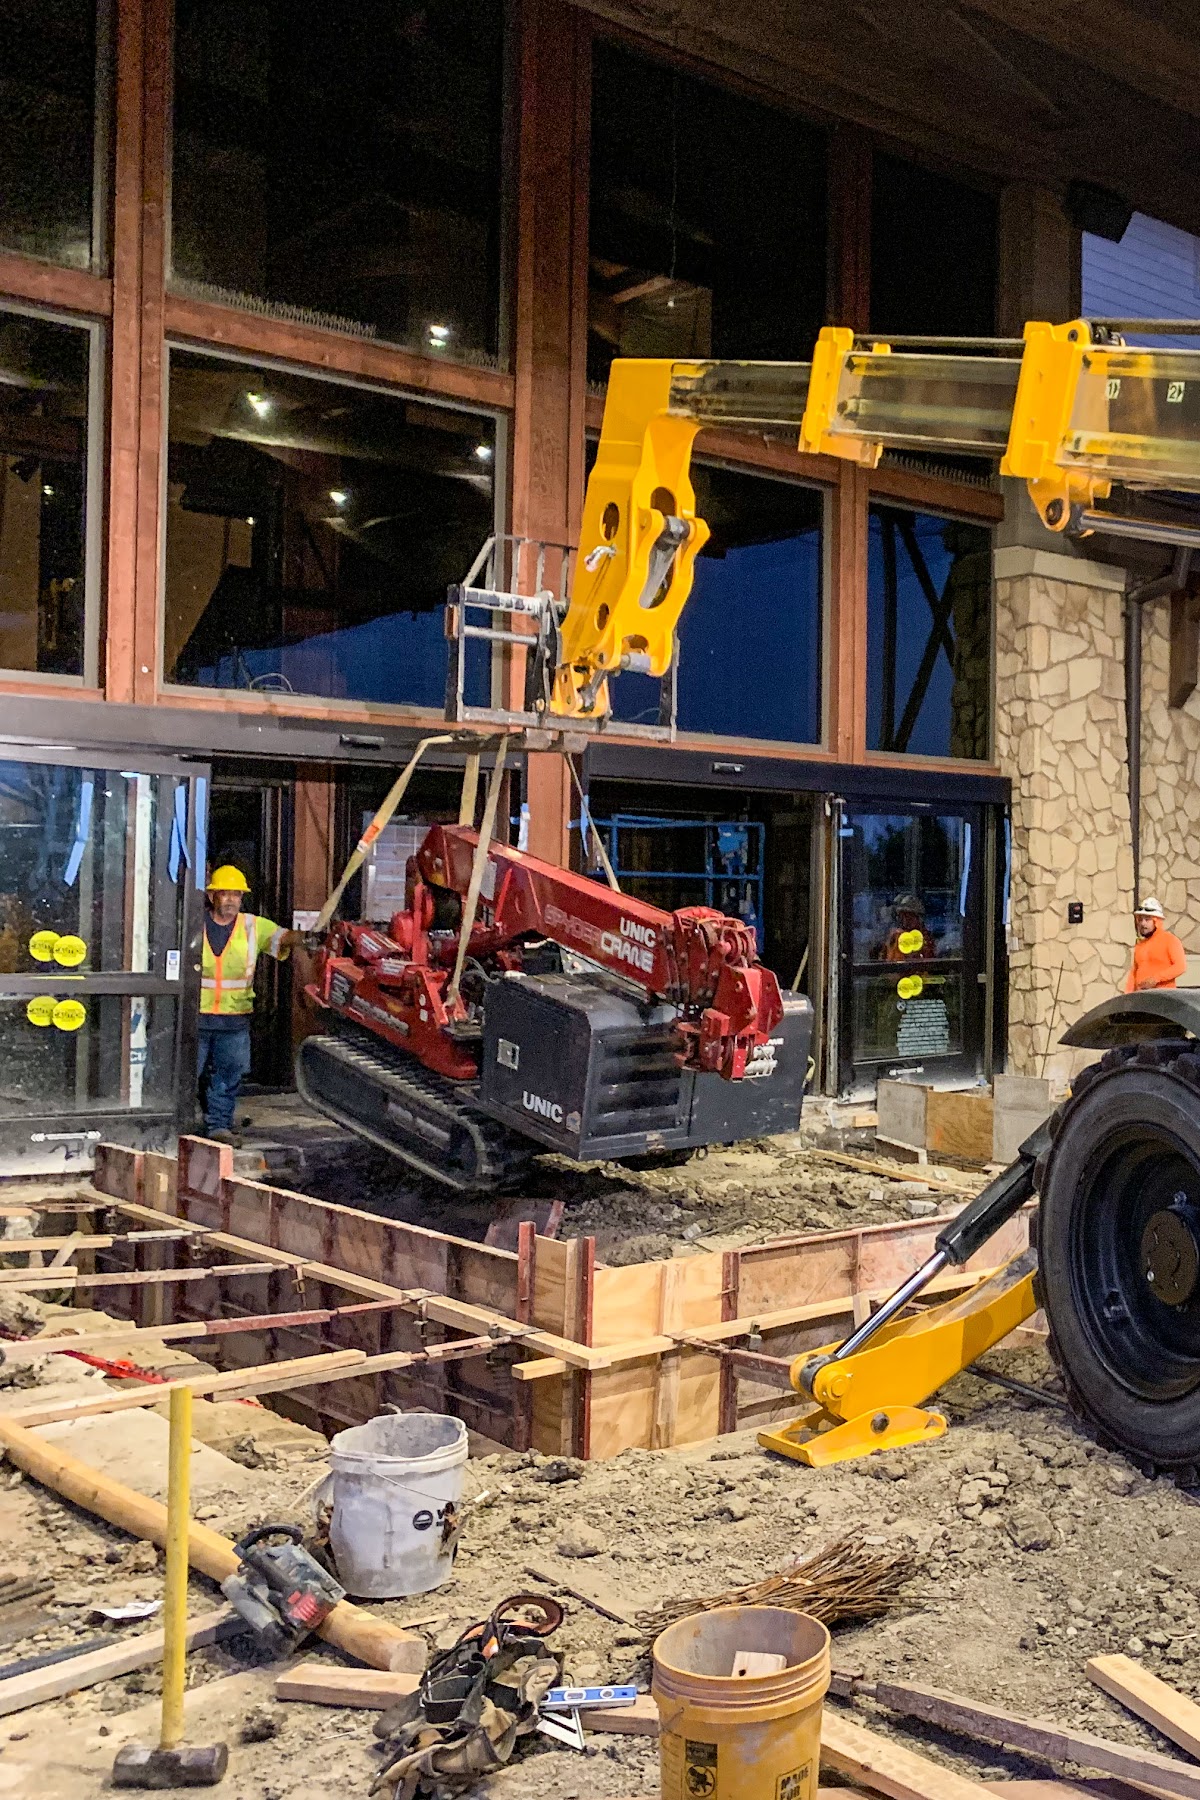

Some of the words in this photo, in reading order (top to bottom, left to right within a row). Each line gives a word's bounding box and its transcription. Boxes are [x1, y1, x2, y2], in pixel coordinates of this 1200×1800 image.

[620, 917, 656, 948] UNIC
[601, 931, 654, 974] CRANE
[522, 1090, 563, 1124] UNIC
